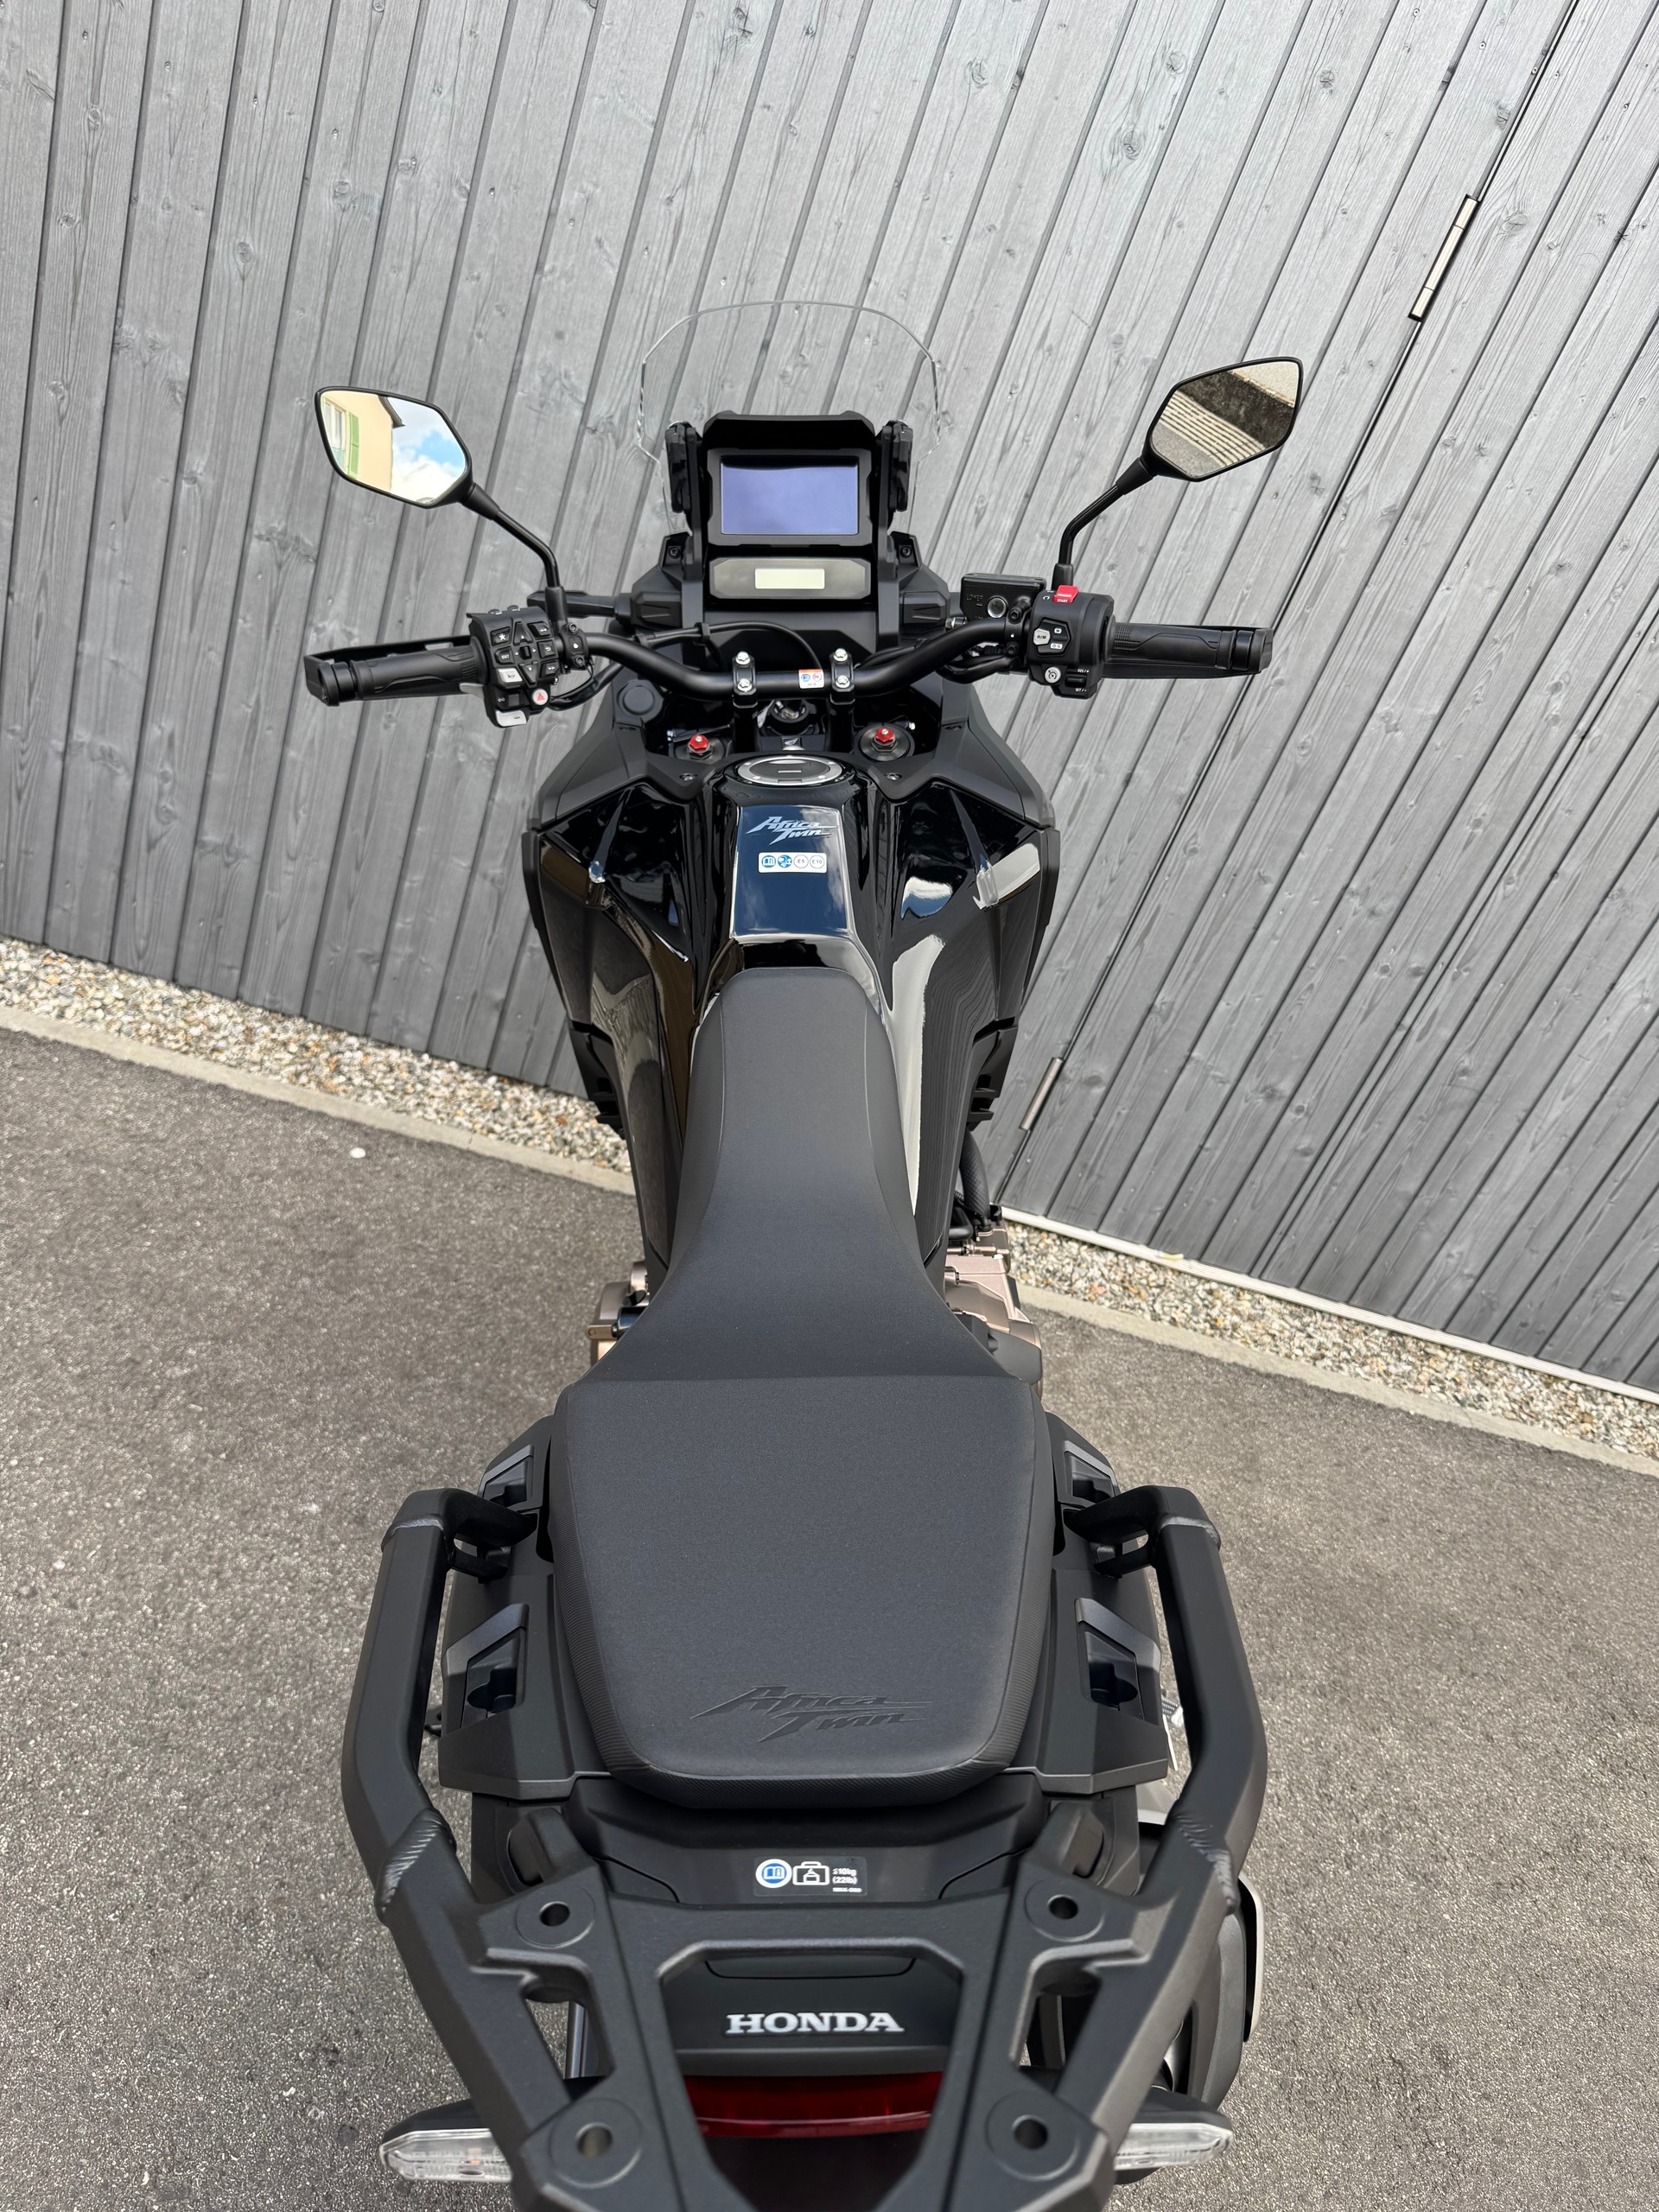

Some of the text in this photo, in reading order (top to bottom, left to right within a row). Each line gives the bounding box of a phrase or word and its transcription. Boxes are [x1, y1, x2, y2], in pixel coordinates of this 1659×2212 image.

[746, 817, 840, 835] Africa
[769, 828, 834, 845] Twin
[690, 1685, 933, 1719] Africa
[756, 1705, 926, 1743] Twin
[725, 2012, 906, 2034] HONDA
